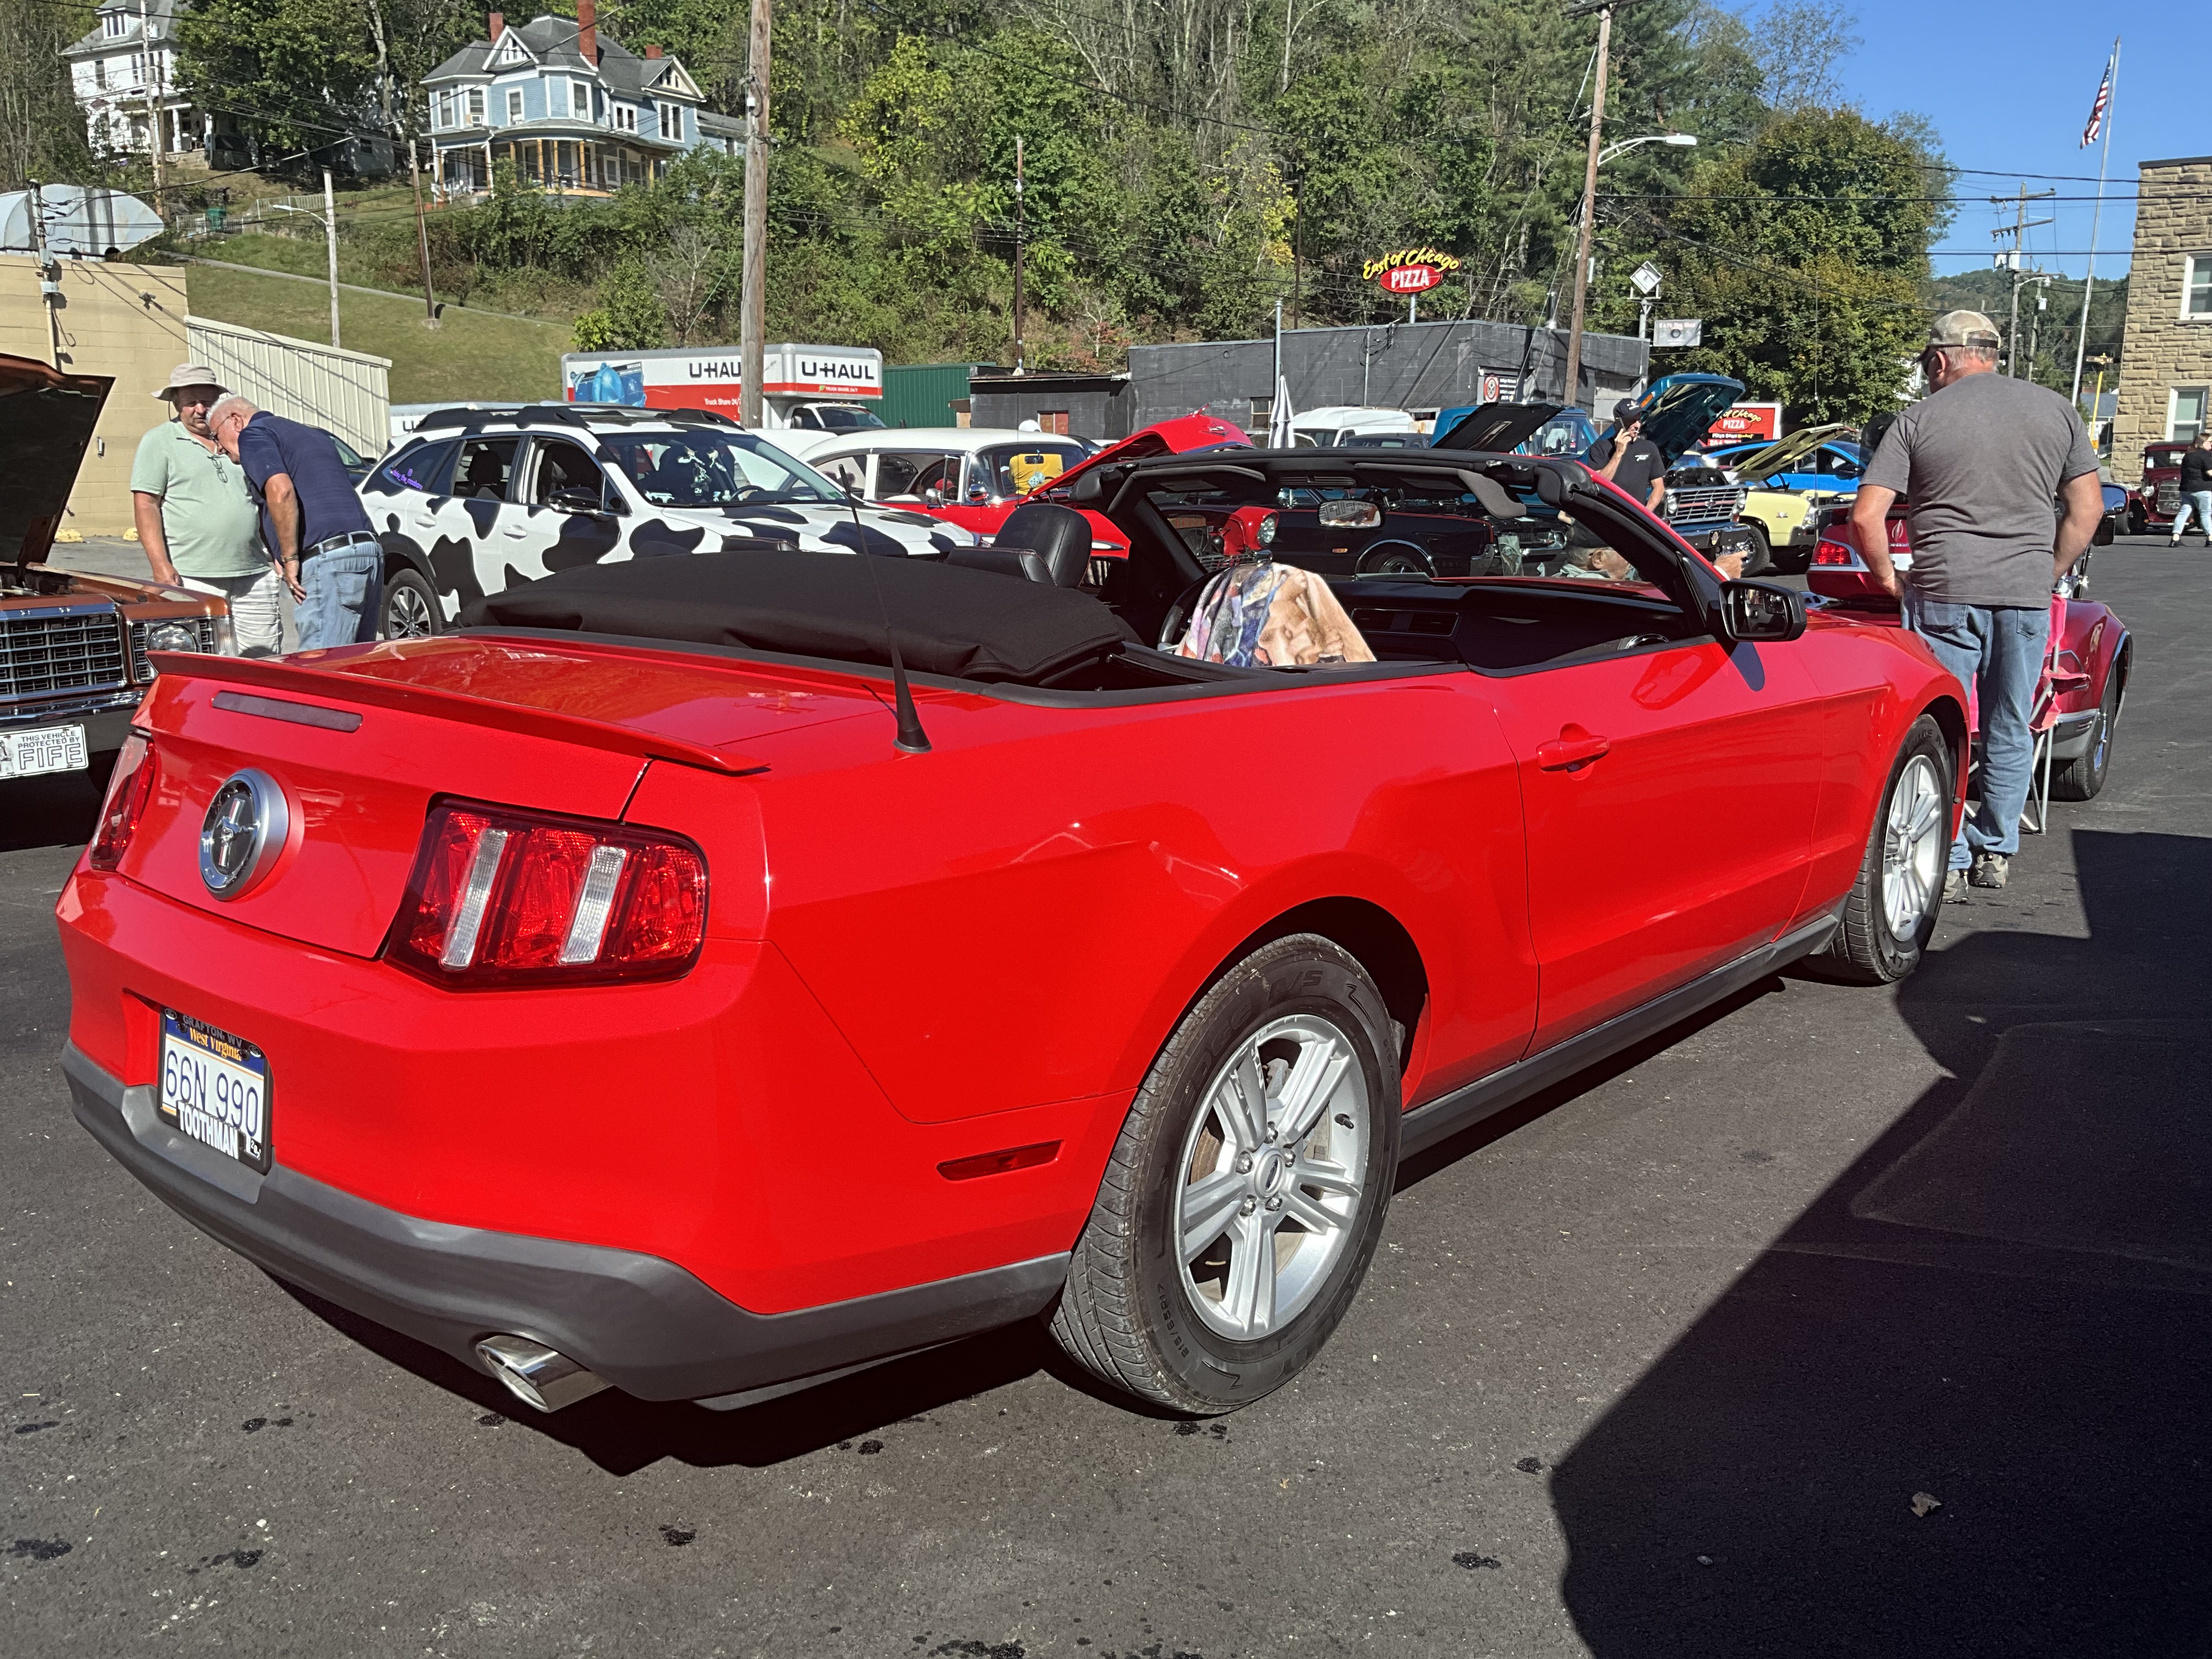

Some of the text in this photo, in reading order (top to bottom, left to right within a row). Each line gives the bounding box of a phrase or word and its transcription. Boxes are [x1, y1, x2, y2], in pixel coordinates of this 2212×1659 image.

[1363, 247, 1459, 279] East of Chicago
[1391, 269, 1430, 288] PIZZA
[689, 362, 741, 378] U-HAU
[802, 362, 874, 380] U-HAUL
[1723, 420, 1745, 429] PIZZA
[1731, 409, 1762, 422] Chicago
[18, 737, 67, 749] PROTECTED
[41, 730, 76, 740] VEHICLE
[19, 743, 82, 770] FIFE
[1266, 970, 1324, 1002] A/S
[182, 1014, 225, 1041] GRAFTON,
[227, 1032, 242, 1048] WV
[189, 1028, 208, 1047] West
[210, 1035, 242, 1062] Virginia
[166, 1049, 258, 1137] 66N 990
[177, 1100, 239, 1160] TOOTHMAN
